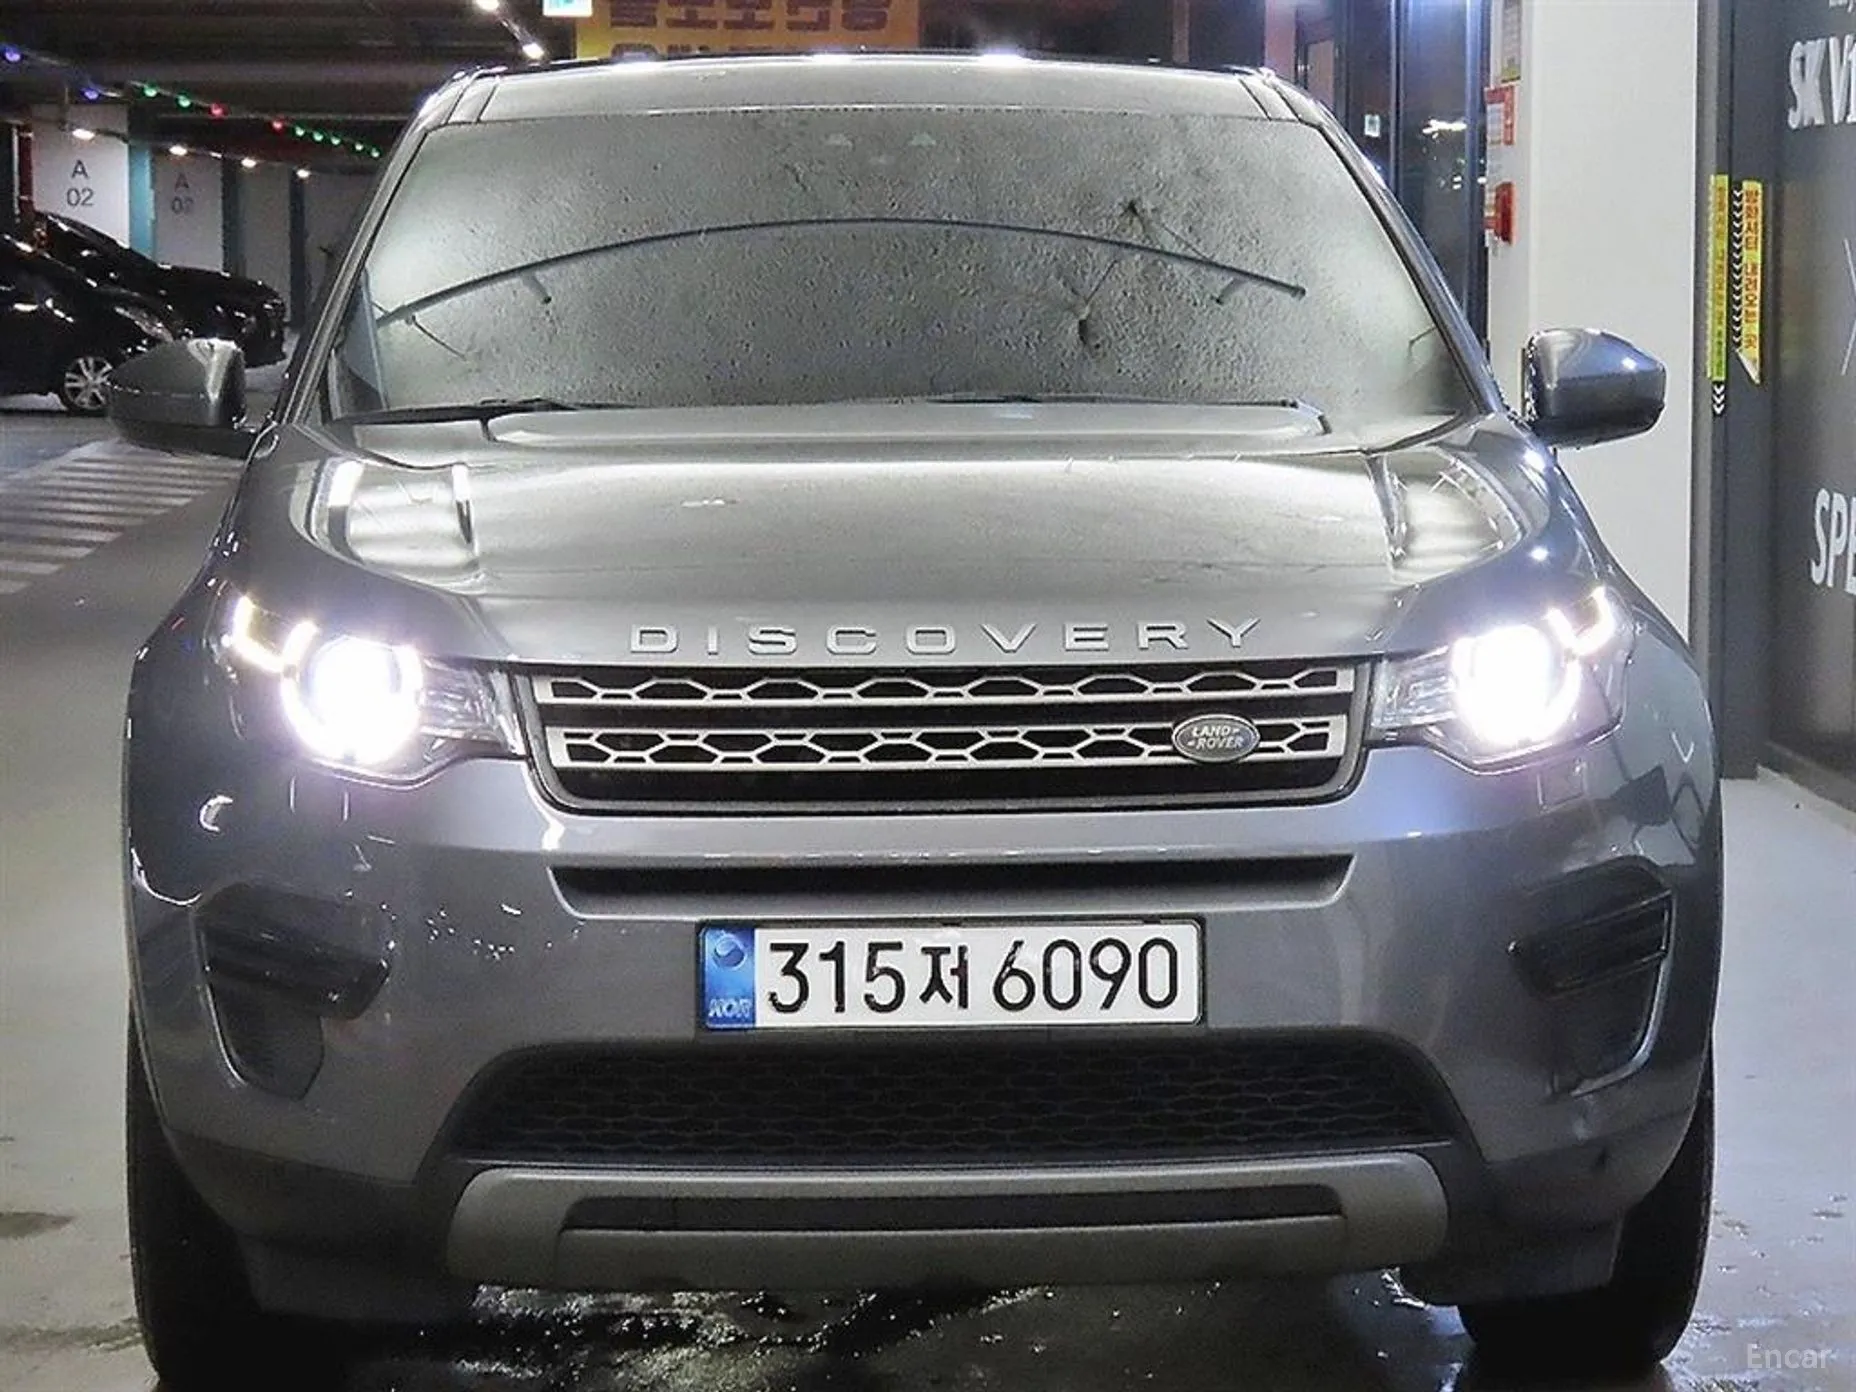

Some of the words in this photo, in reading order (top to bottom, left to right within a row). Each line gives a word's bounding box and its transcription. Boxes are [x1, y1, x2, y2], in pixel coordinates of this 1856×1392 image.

[1787, 38, 1827, 129] SK
[71, 159, 89, 179] A
[174, 173, 189, 191] A
[67, 187, 94, 207] 02
[629, 617, 1261, 655] DISCOVERY
[1191, 725, 1231, 737] LAND
[1195, 736, 1244, 750] ROVER
[767, 940, 968, 1013] 315저
[993, 937, 1178, 1012] 6090
